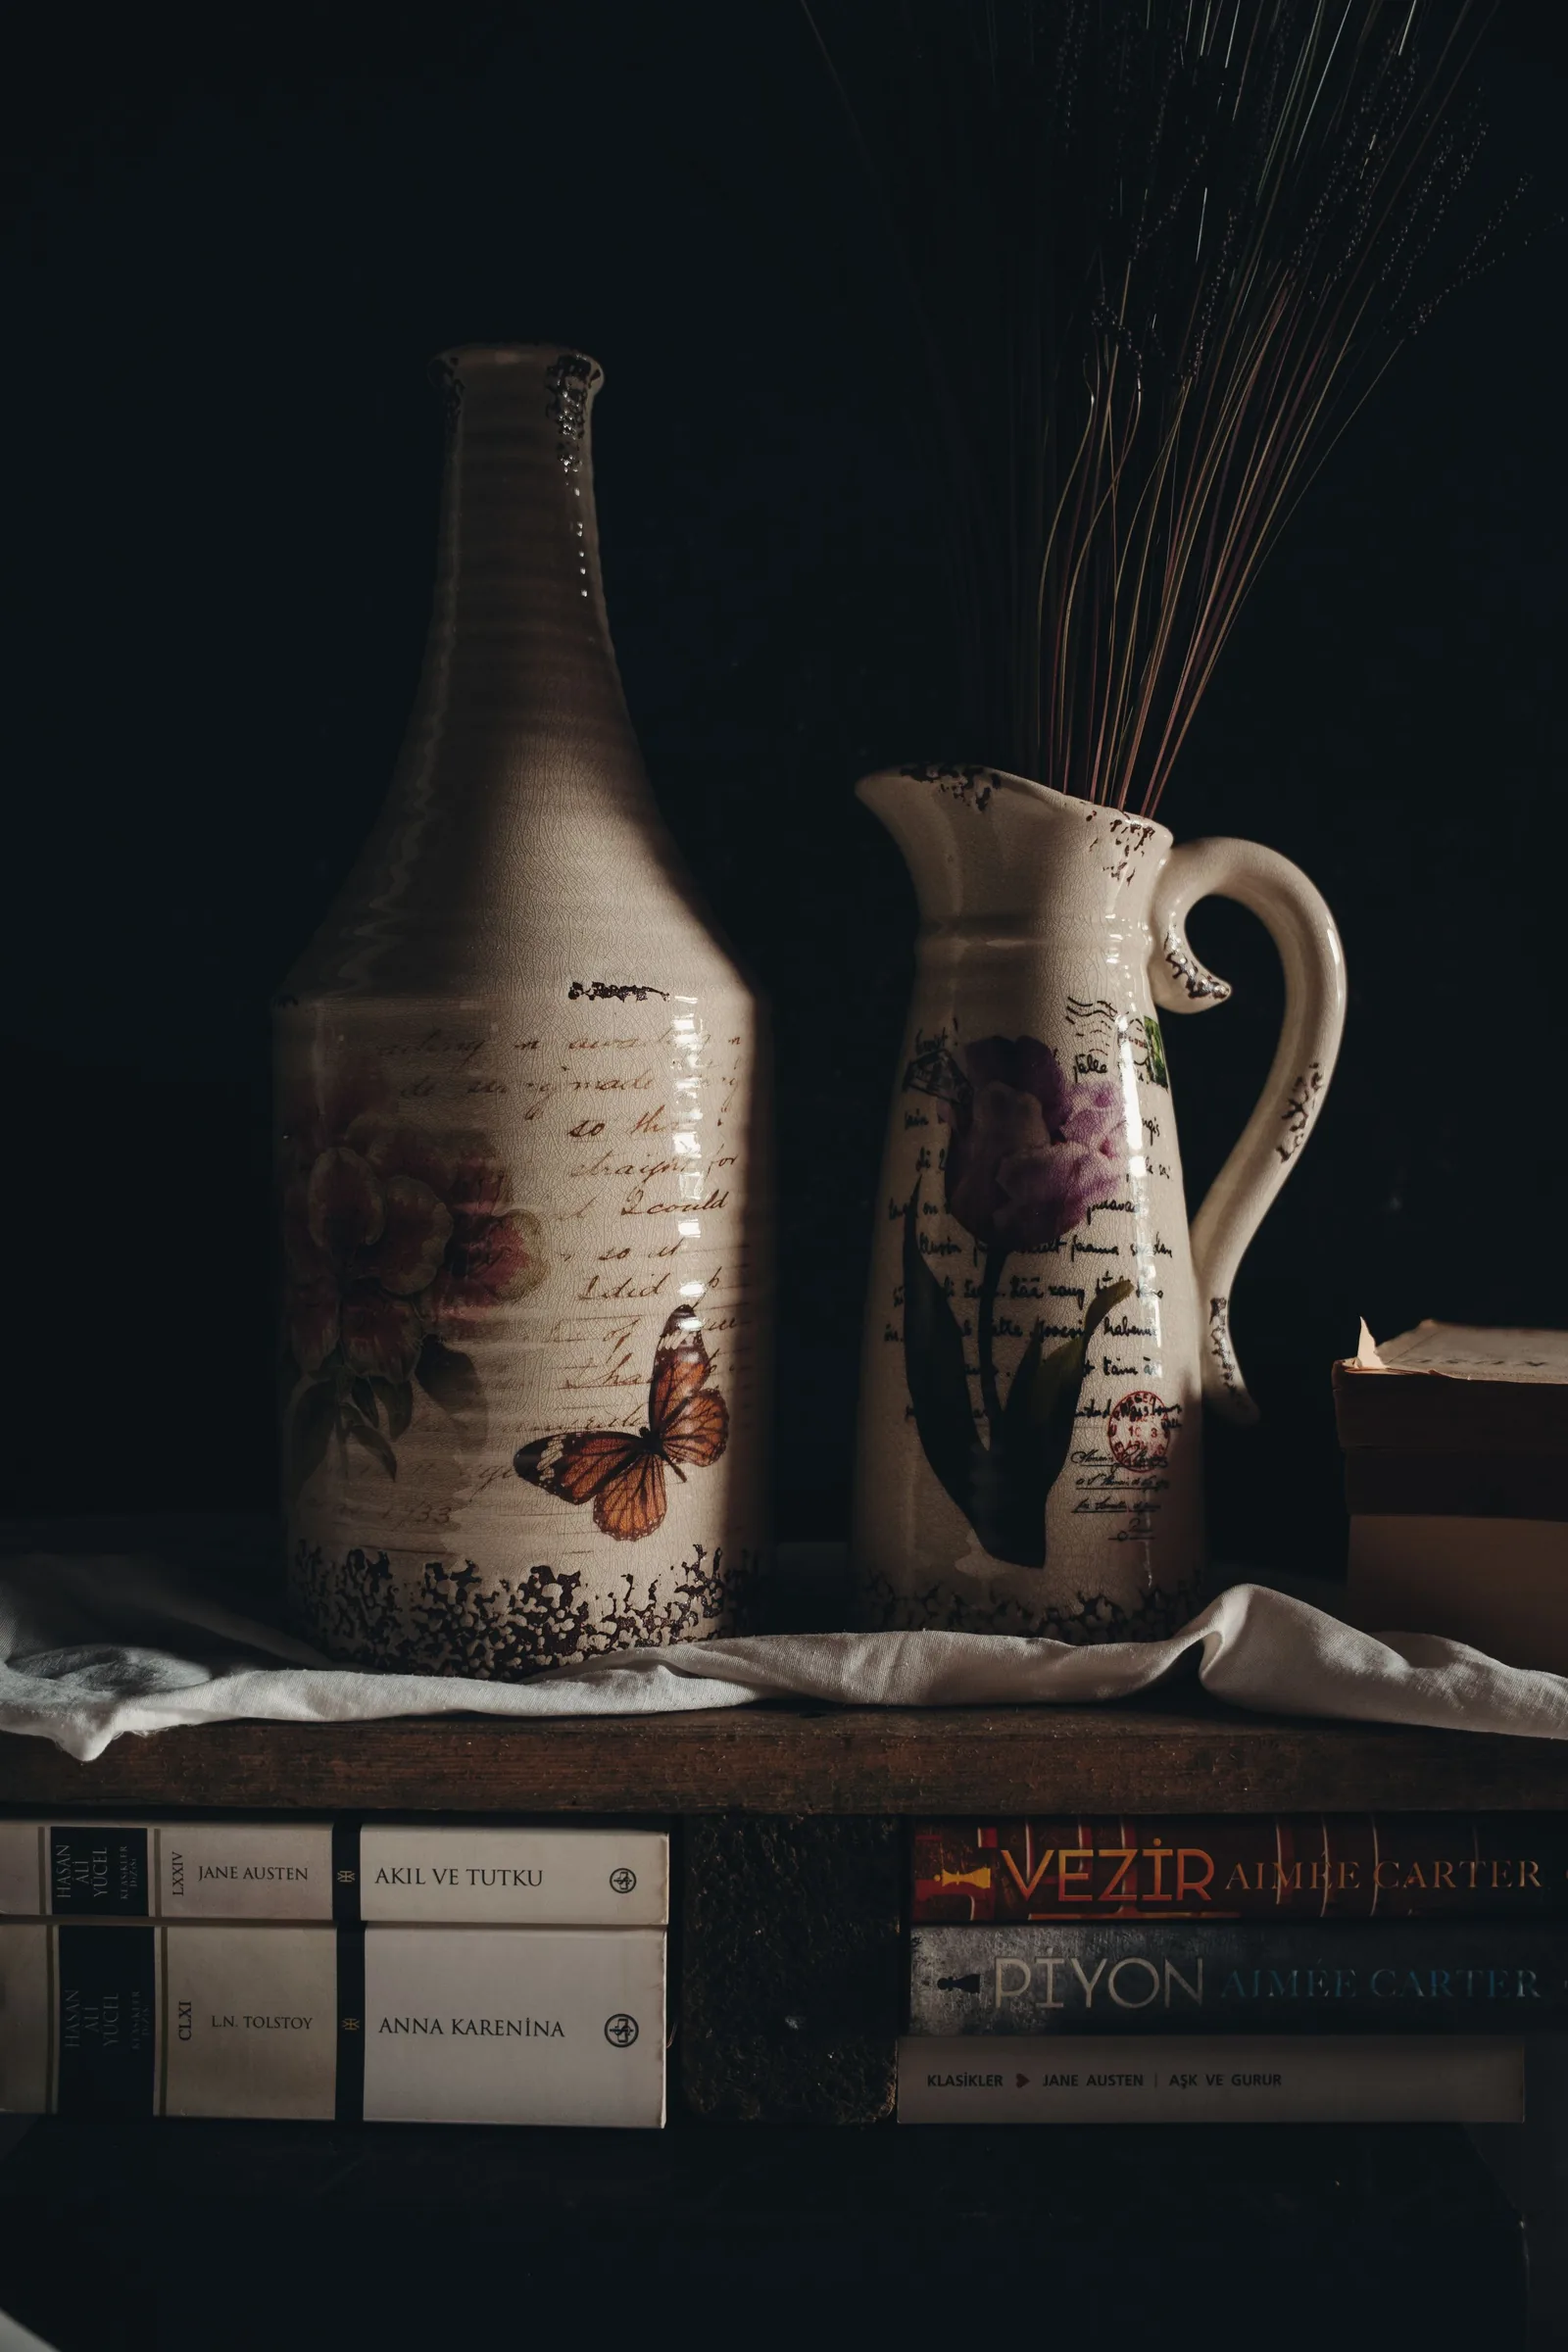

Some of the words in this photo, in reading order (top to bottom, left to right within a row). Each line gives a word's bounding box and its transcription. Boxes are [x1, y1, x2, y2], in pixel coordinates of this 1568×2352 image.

[56, 1843, 71, 1899] HASAN
[90, 1846, 109, 1898] YÜCEL
[172, 1850, 185, 1896] LXXIV
[197, 1865, 238, 1883] JANE
[242, 1866, 309, 1882] AUSTEN
[375, 1867, 426, 1886] AKIL
[432, 1867, 460, 1886] VE
[465, 1868, 544, 1887] TUTKU
[1000, 1837, 1216, 1902] VEZİR
[1373, 1860, 1544, 1890] CARTER
[1371, 1968, 1542, 1998] CARTER
[64, 1988, 81, 2049] HASAN
[178, 1999, 192, 2041] CLXI
[212, 2015, 238, 2030] L.N.
[243, 2015, 313, 2031] TOLSTOY
[378, 2017, 444, 2035] ANNA
[451, 2017, 565, 2038] KARENİNA
[927, 2071, 1004, 2087] KLASİKLER
[1043, 2074, 1079, 2087] JANE
[1086, 2074, 1144, 2087] AUSTEN
[1169, 2074, 1198, 2089] AŞK
[1205, 2074, 1224, 2087] VE
[1231, 2074, 1282, 2087] GURUR
